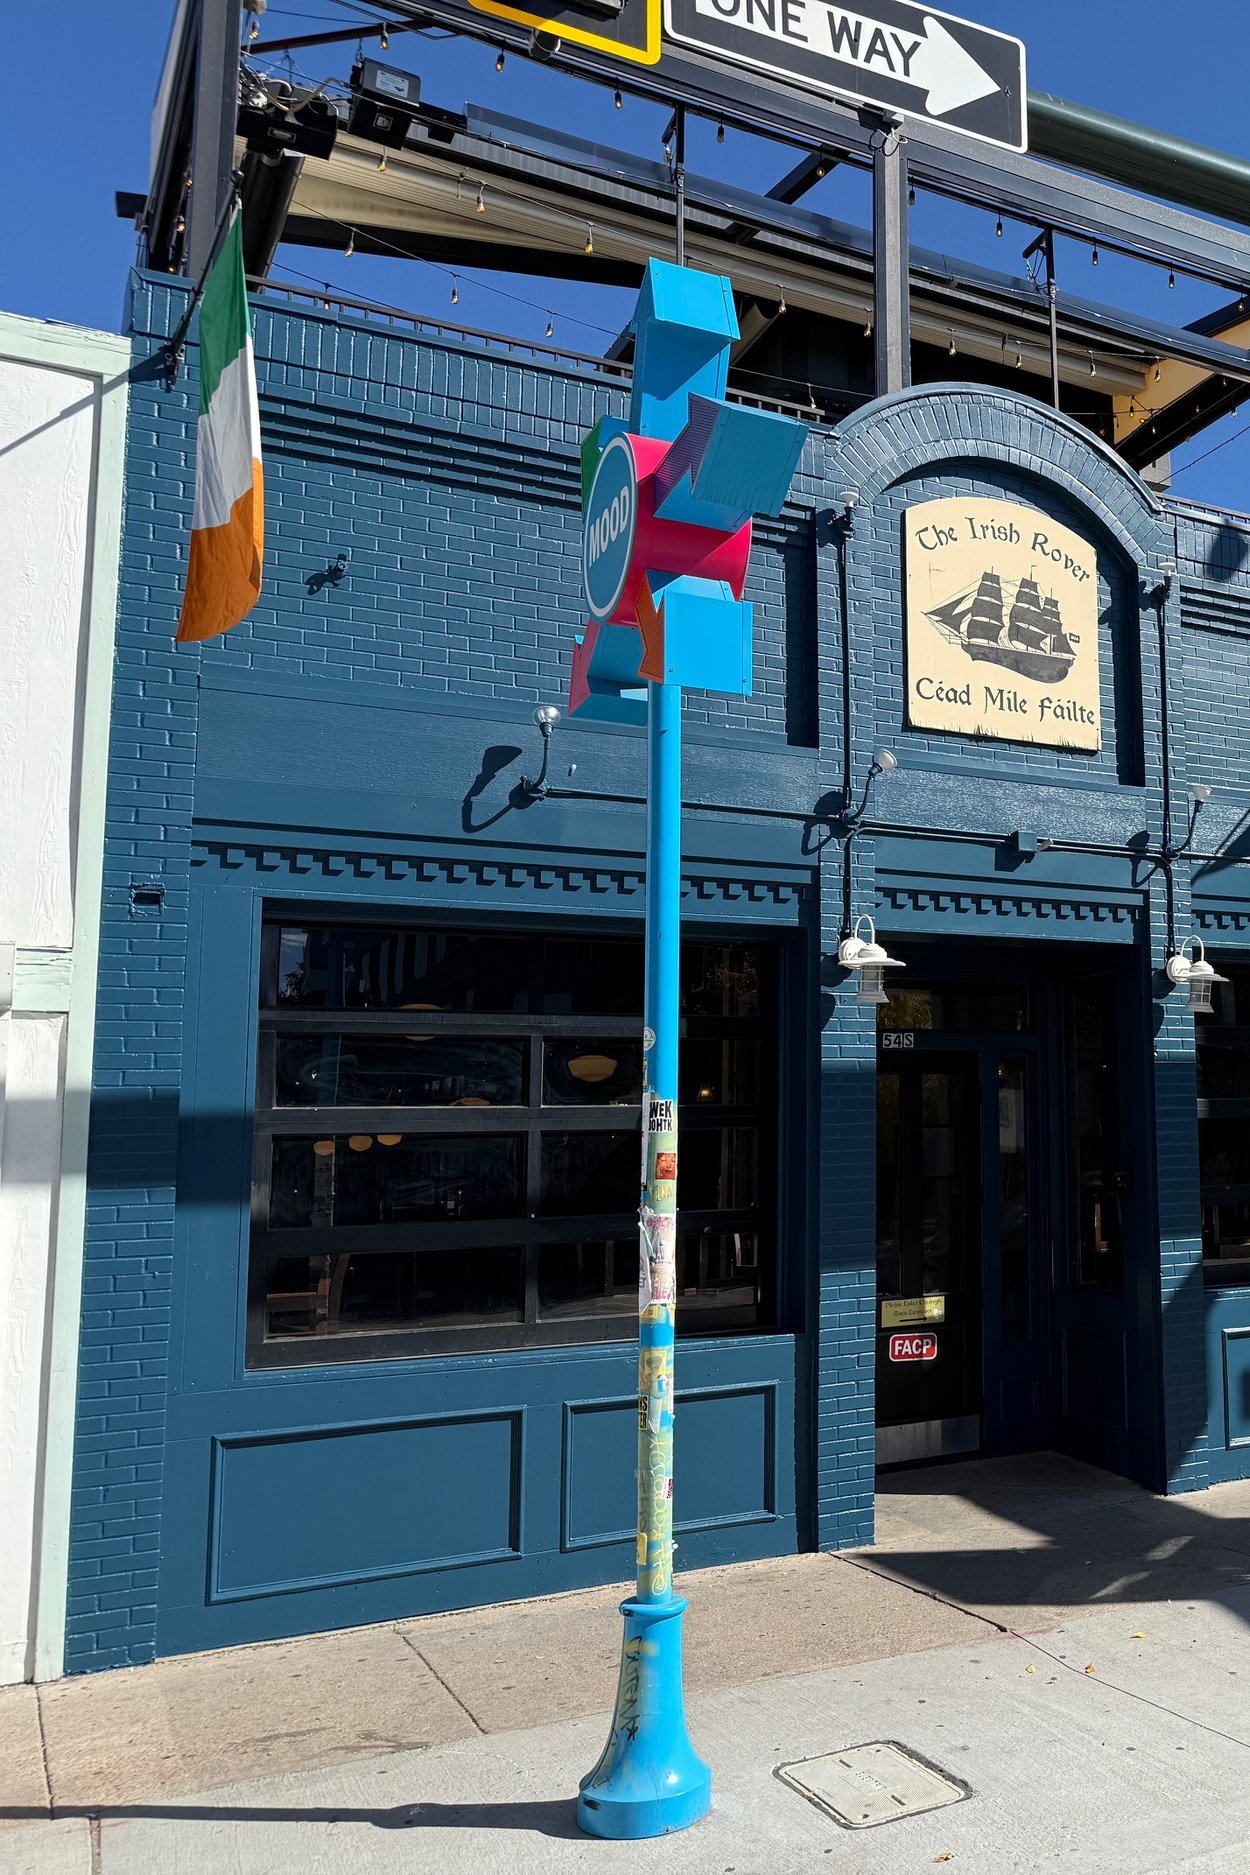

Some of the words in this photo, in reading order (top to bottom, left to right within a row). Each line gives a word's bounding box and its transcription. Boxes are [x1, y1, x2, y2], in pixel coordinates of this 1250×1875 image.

[827, 10, 921, 77] WAY
[588, 484, 631, 568] MOOD
[915, 525, 958, 550] The
[964, 517, 1021, 545] Irish
[1030, 532, 1090, 583] Rover
[894, 1338, 932, 1356] FACP
